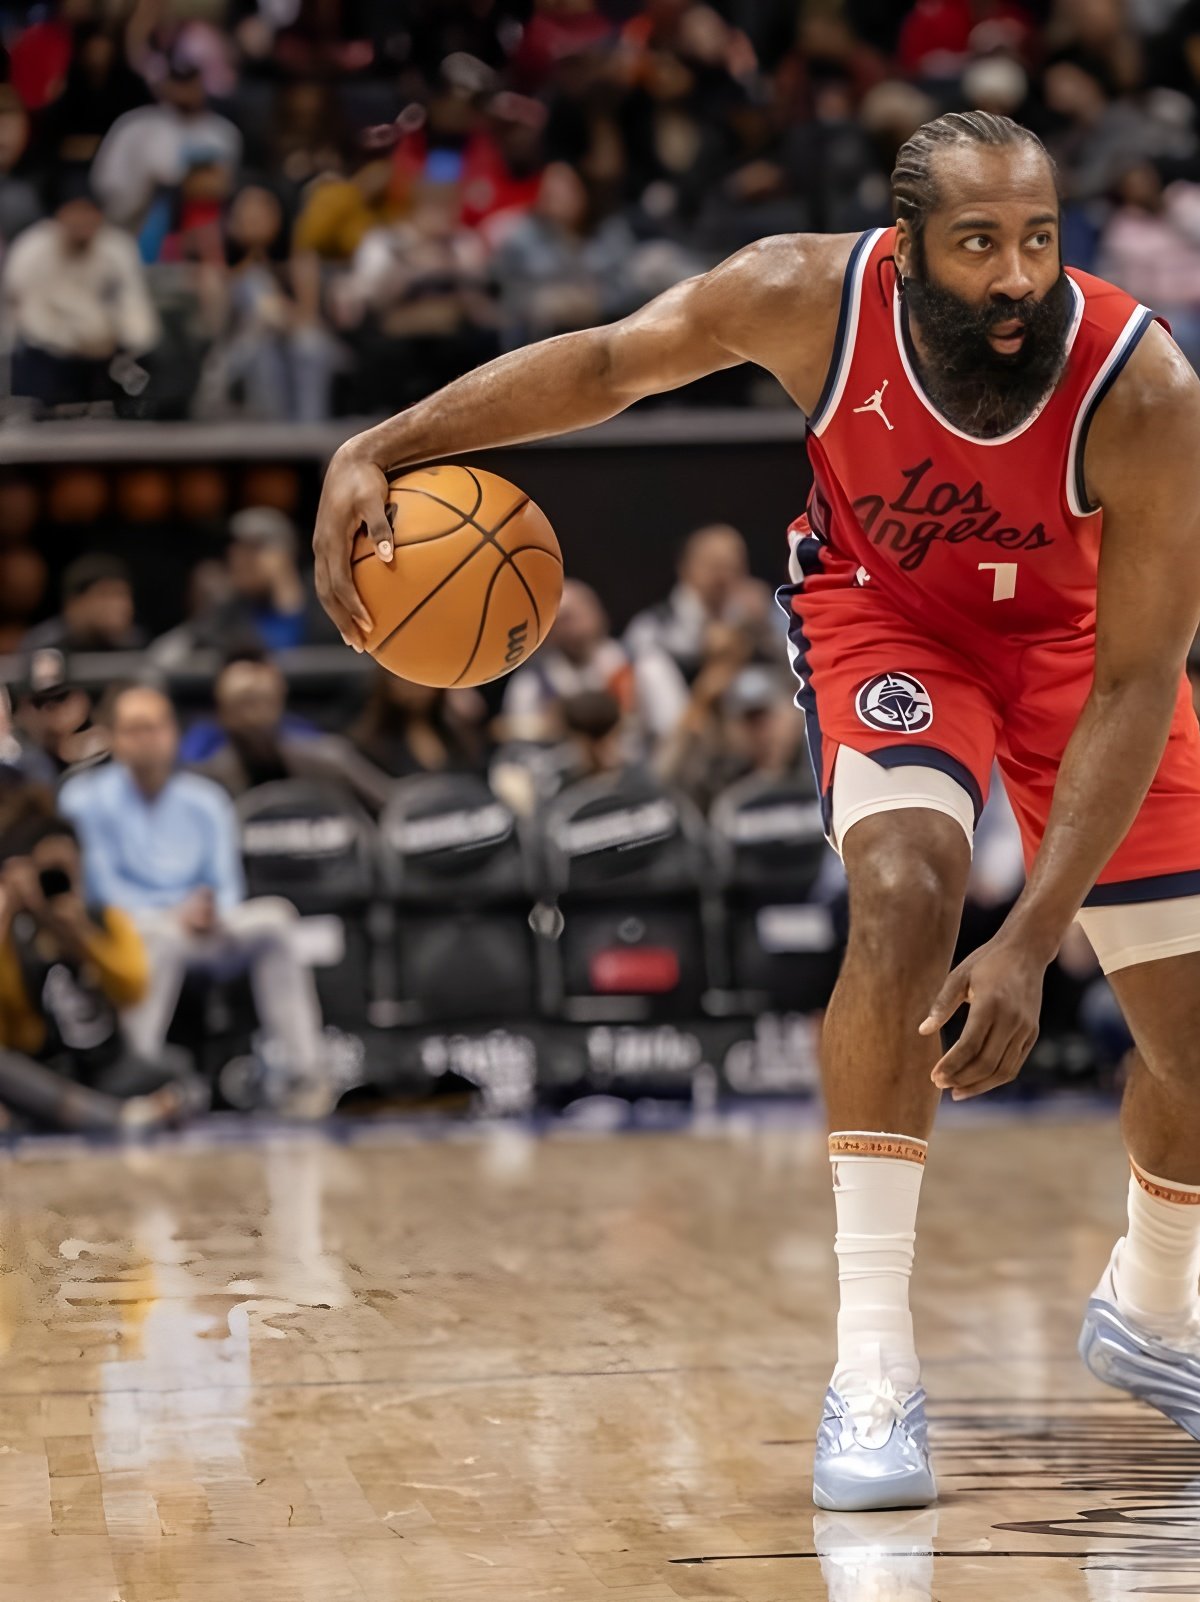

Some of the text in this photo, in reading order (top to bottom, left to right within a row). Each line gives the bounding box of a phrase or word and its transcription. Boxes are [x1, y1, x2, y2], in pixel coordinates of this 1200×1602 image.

[888, 457, 991, 516] Los
[852, 495, 1056, 571] Angeles
[978, 562, 1018, 602] 1
